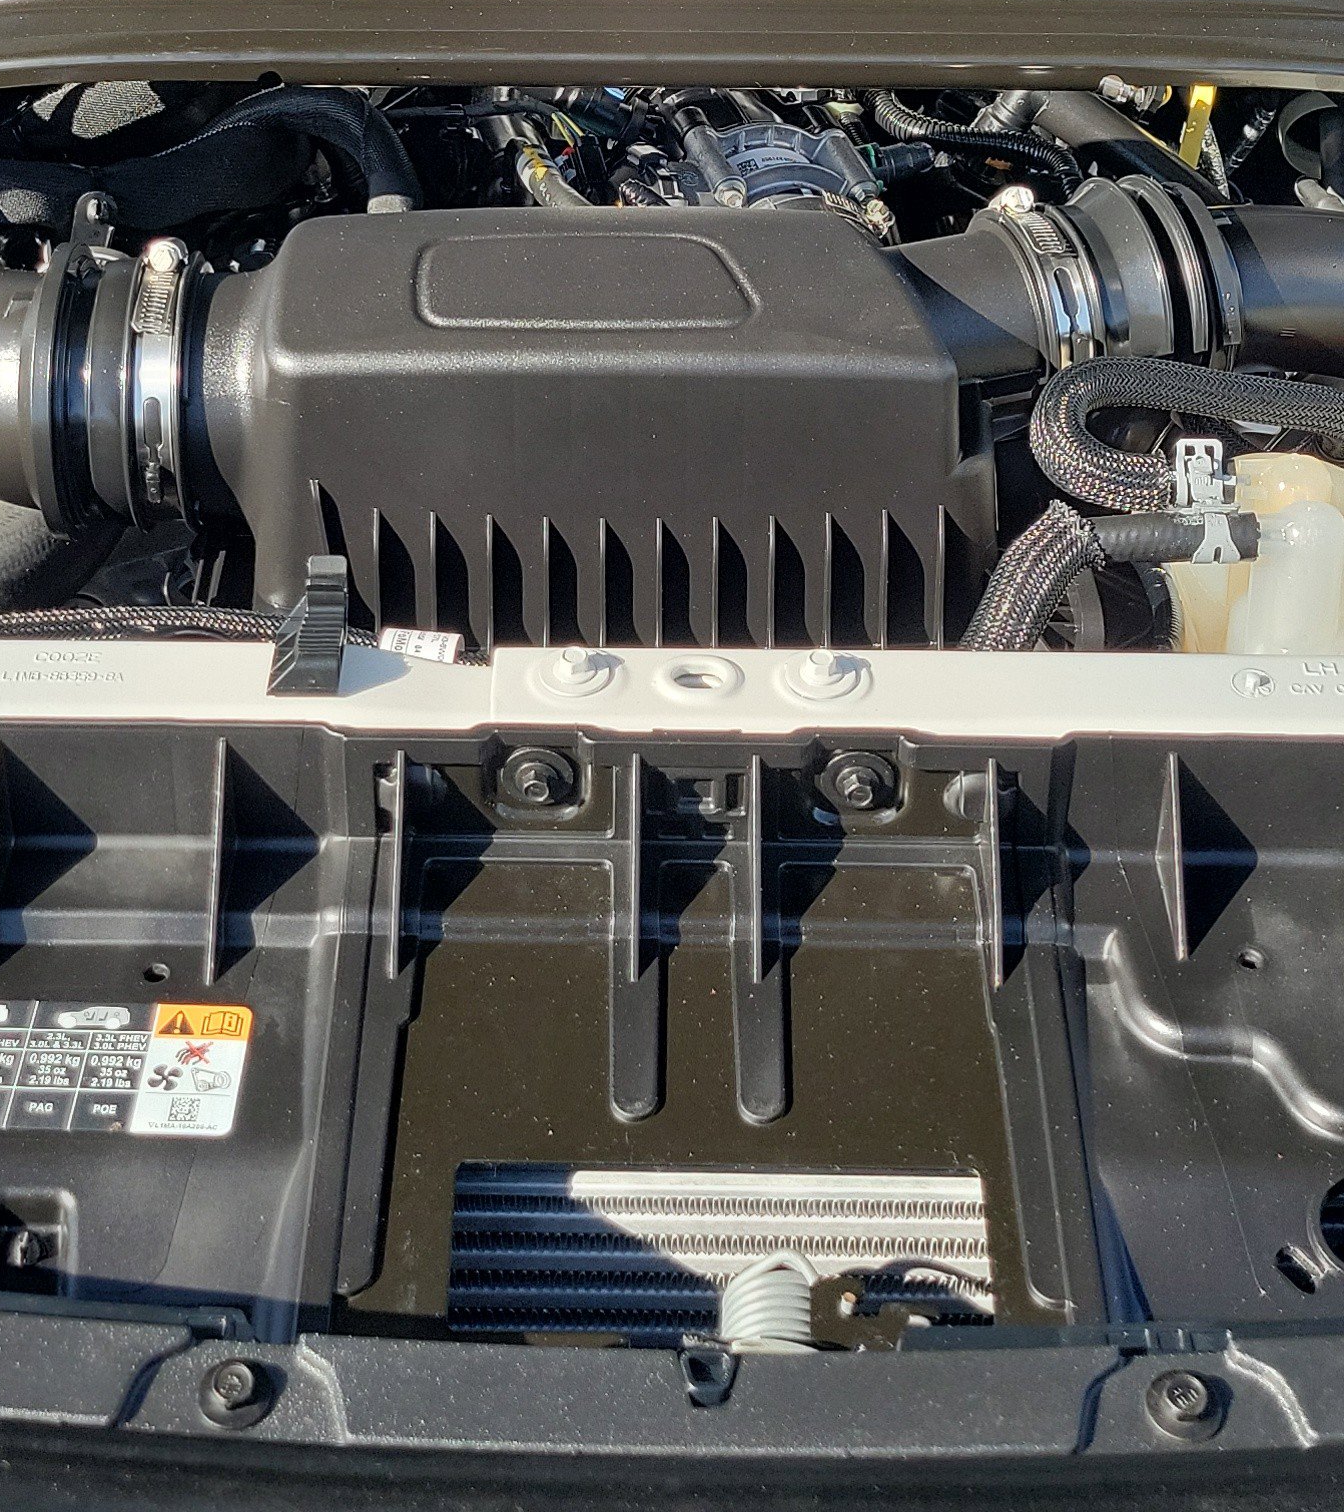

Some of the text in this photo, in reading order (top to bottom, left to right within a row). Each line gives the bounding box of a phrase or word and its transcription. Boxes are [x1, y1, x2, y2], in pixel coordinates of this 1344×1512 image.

[1302, 662, 1339, 676] LH
[95, 1033, 149, 1043] 3.3L FHEV
[29, 1040, 50, 1048] 3.0L
[62, 1041, 85, 1049] 3.3L
[93, 1042, 147, 1051] 3.0L PHEV
[29, 1052, 81, 1067] 0.992 kg
[90, 1054, 142, 1070] 0.992 kg
[37, 1064, 67, 1075] 35 oz
[99, 1067, 128, 1078] 35 oz
[28, 1074, 70, 1085] 2.19 lbs
[90, 1077, 131, 1088] 2.19 lbs
[28, 1102, 54, 1113] PAG
[92, 1104, 118, 1115] POE
